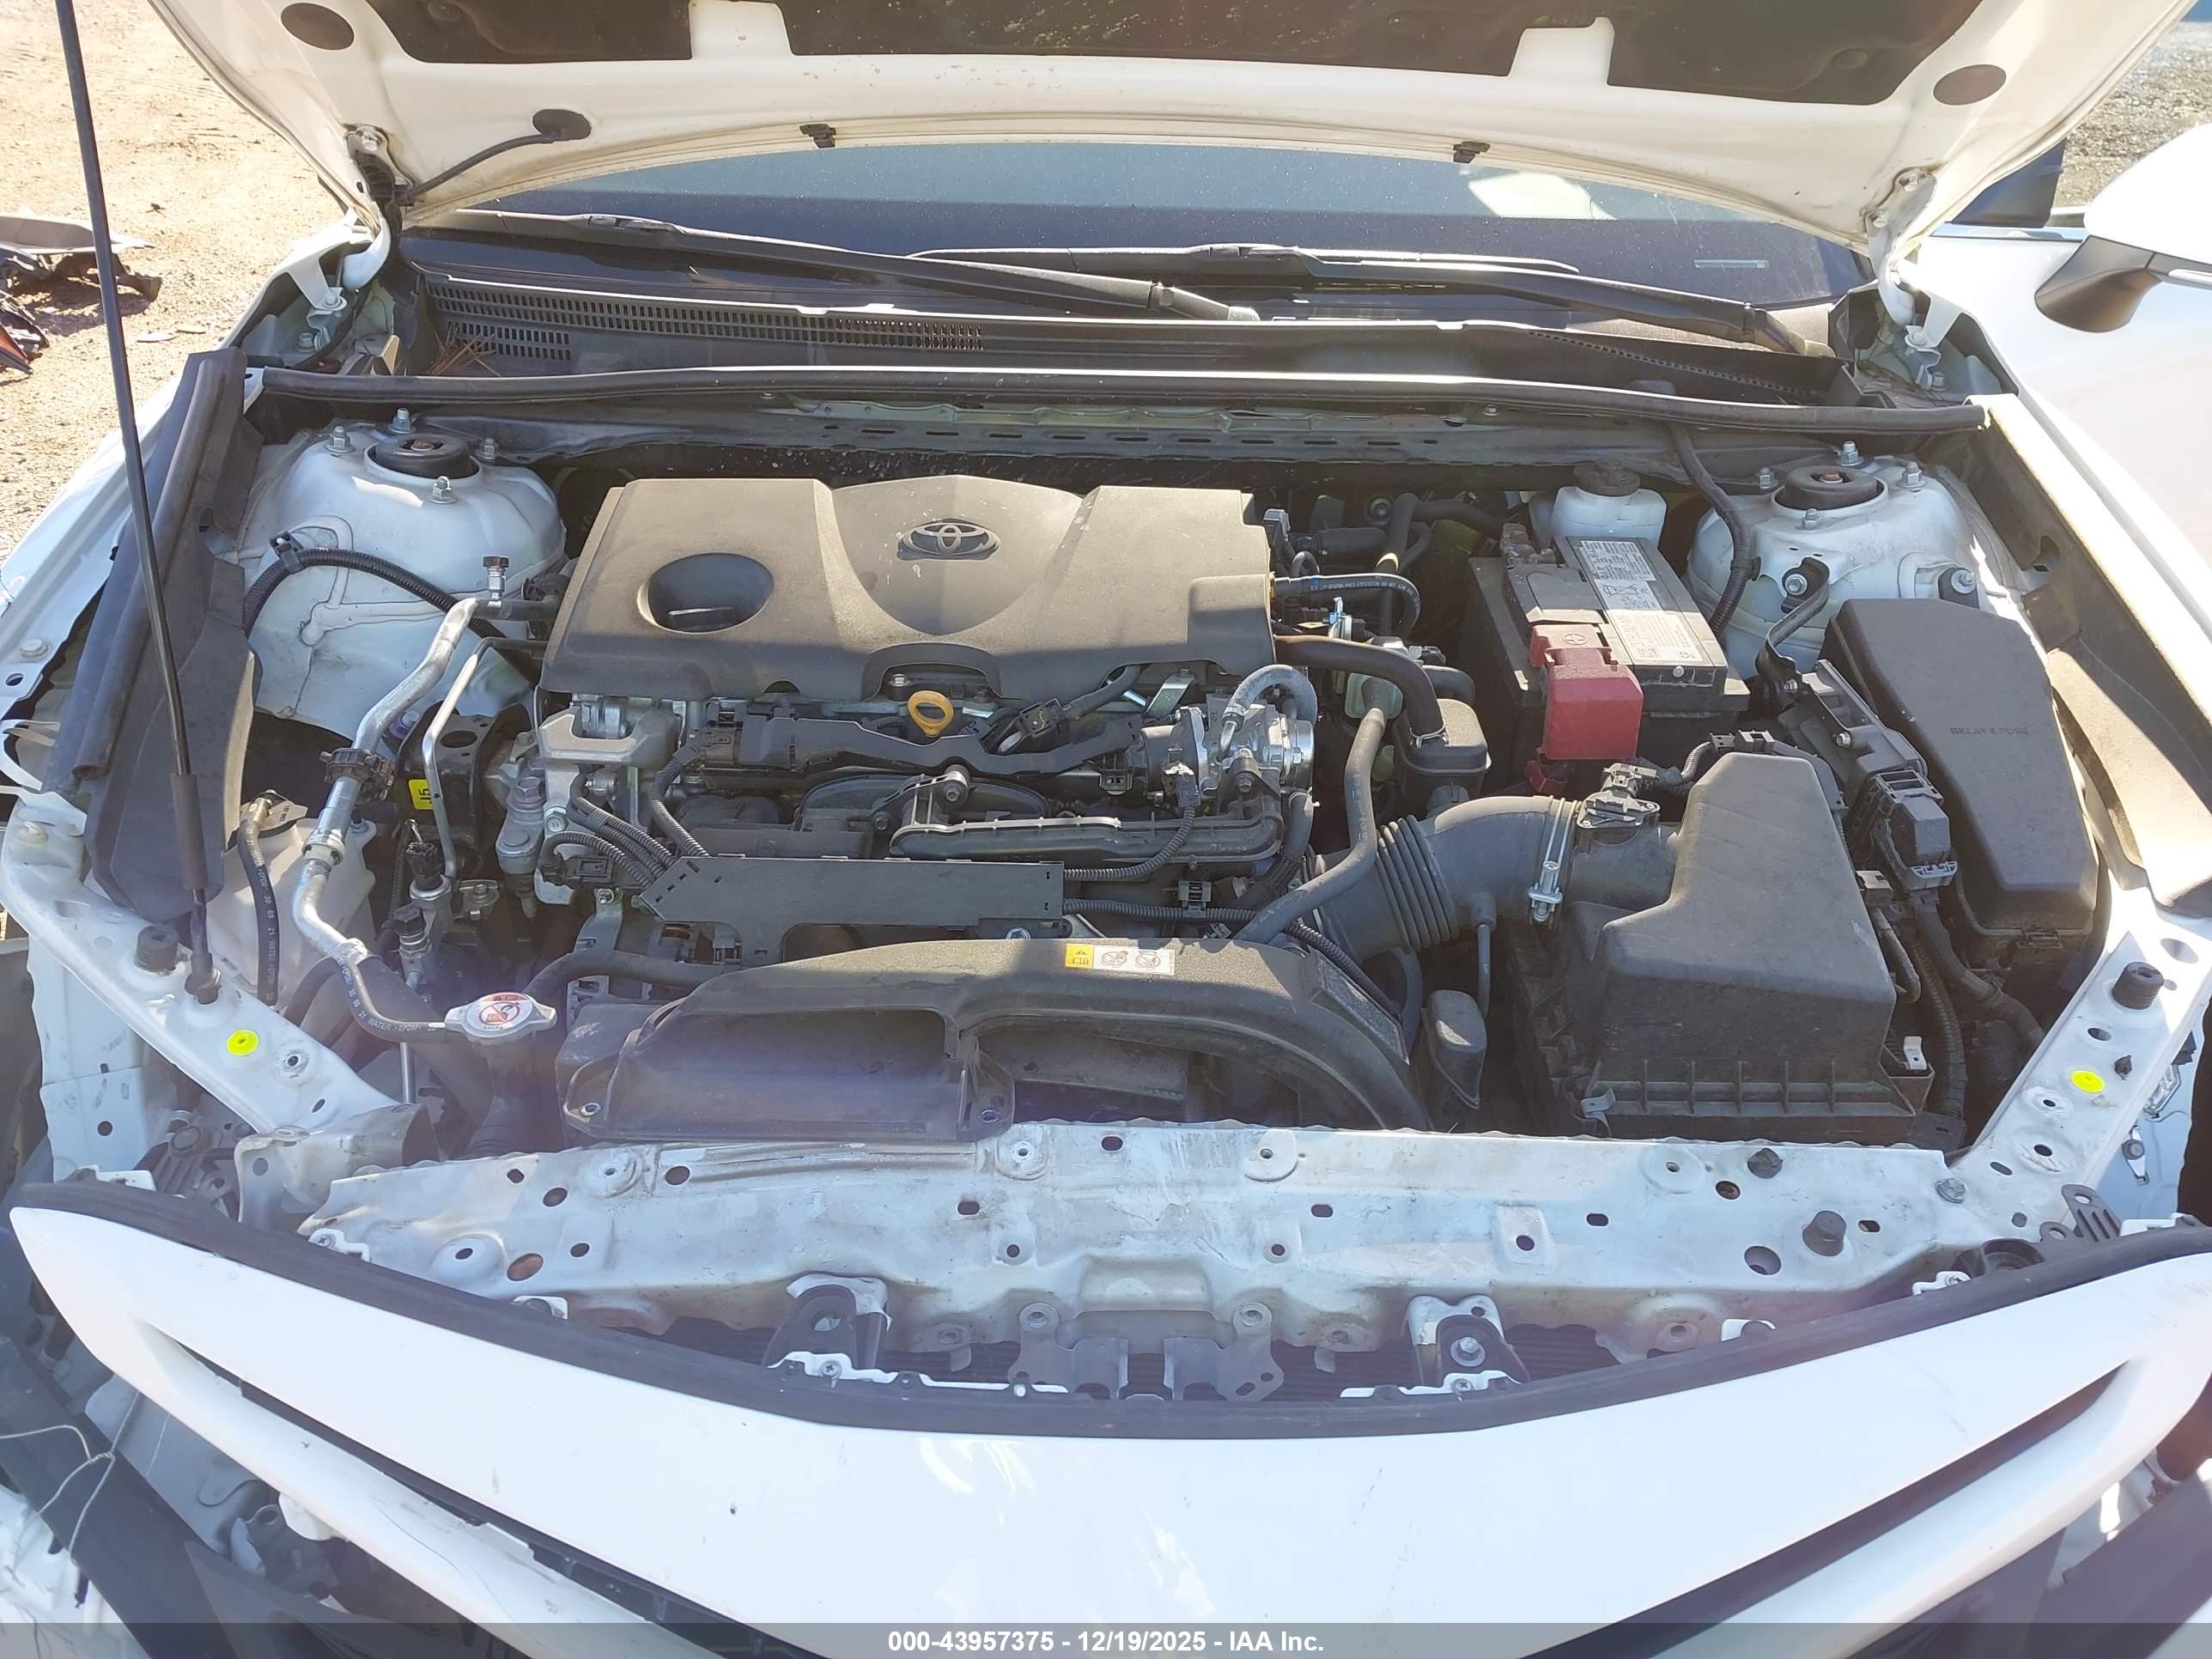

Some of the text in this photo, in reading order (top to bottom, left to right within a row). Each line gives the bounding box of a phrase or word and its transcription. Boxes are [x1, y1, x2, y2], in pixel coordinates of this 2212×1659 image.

[1949, 727, 1987, 736] RELAY
[2000, 726, 2032, 736] FUSE
[368, 1018, 392, 1030] WATER
